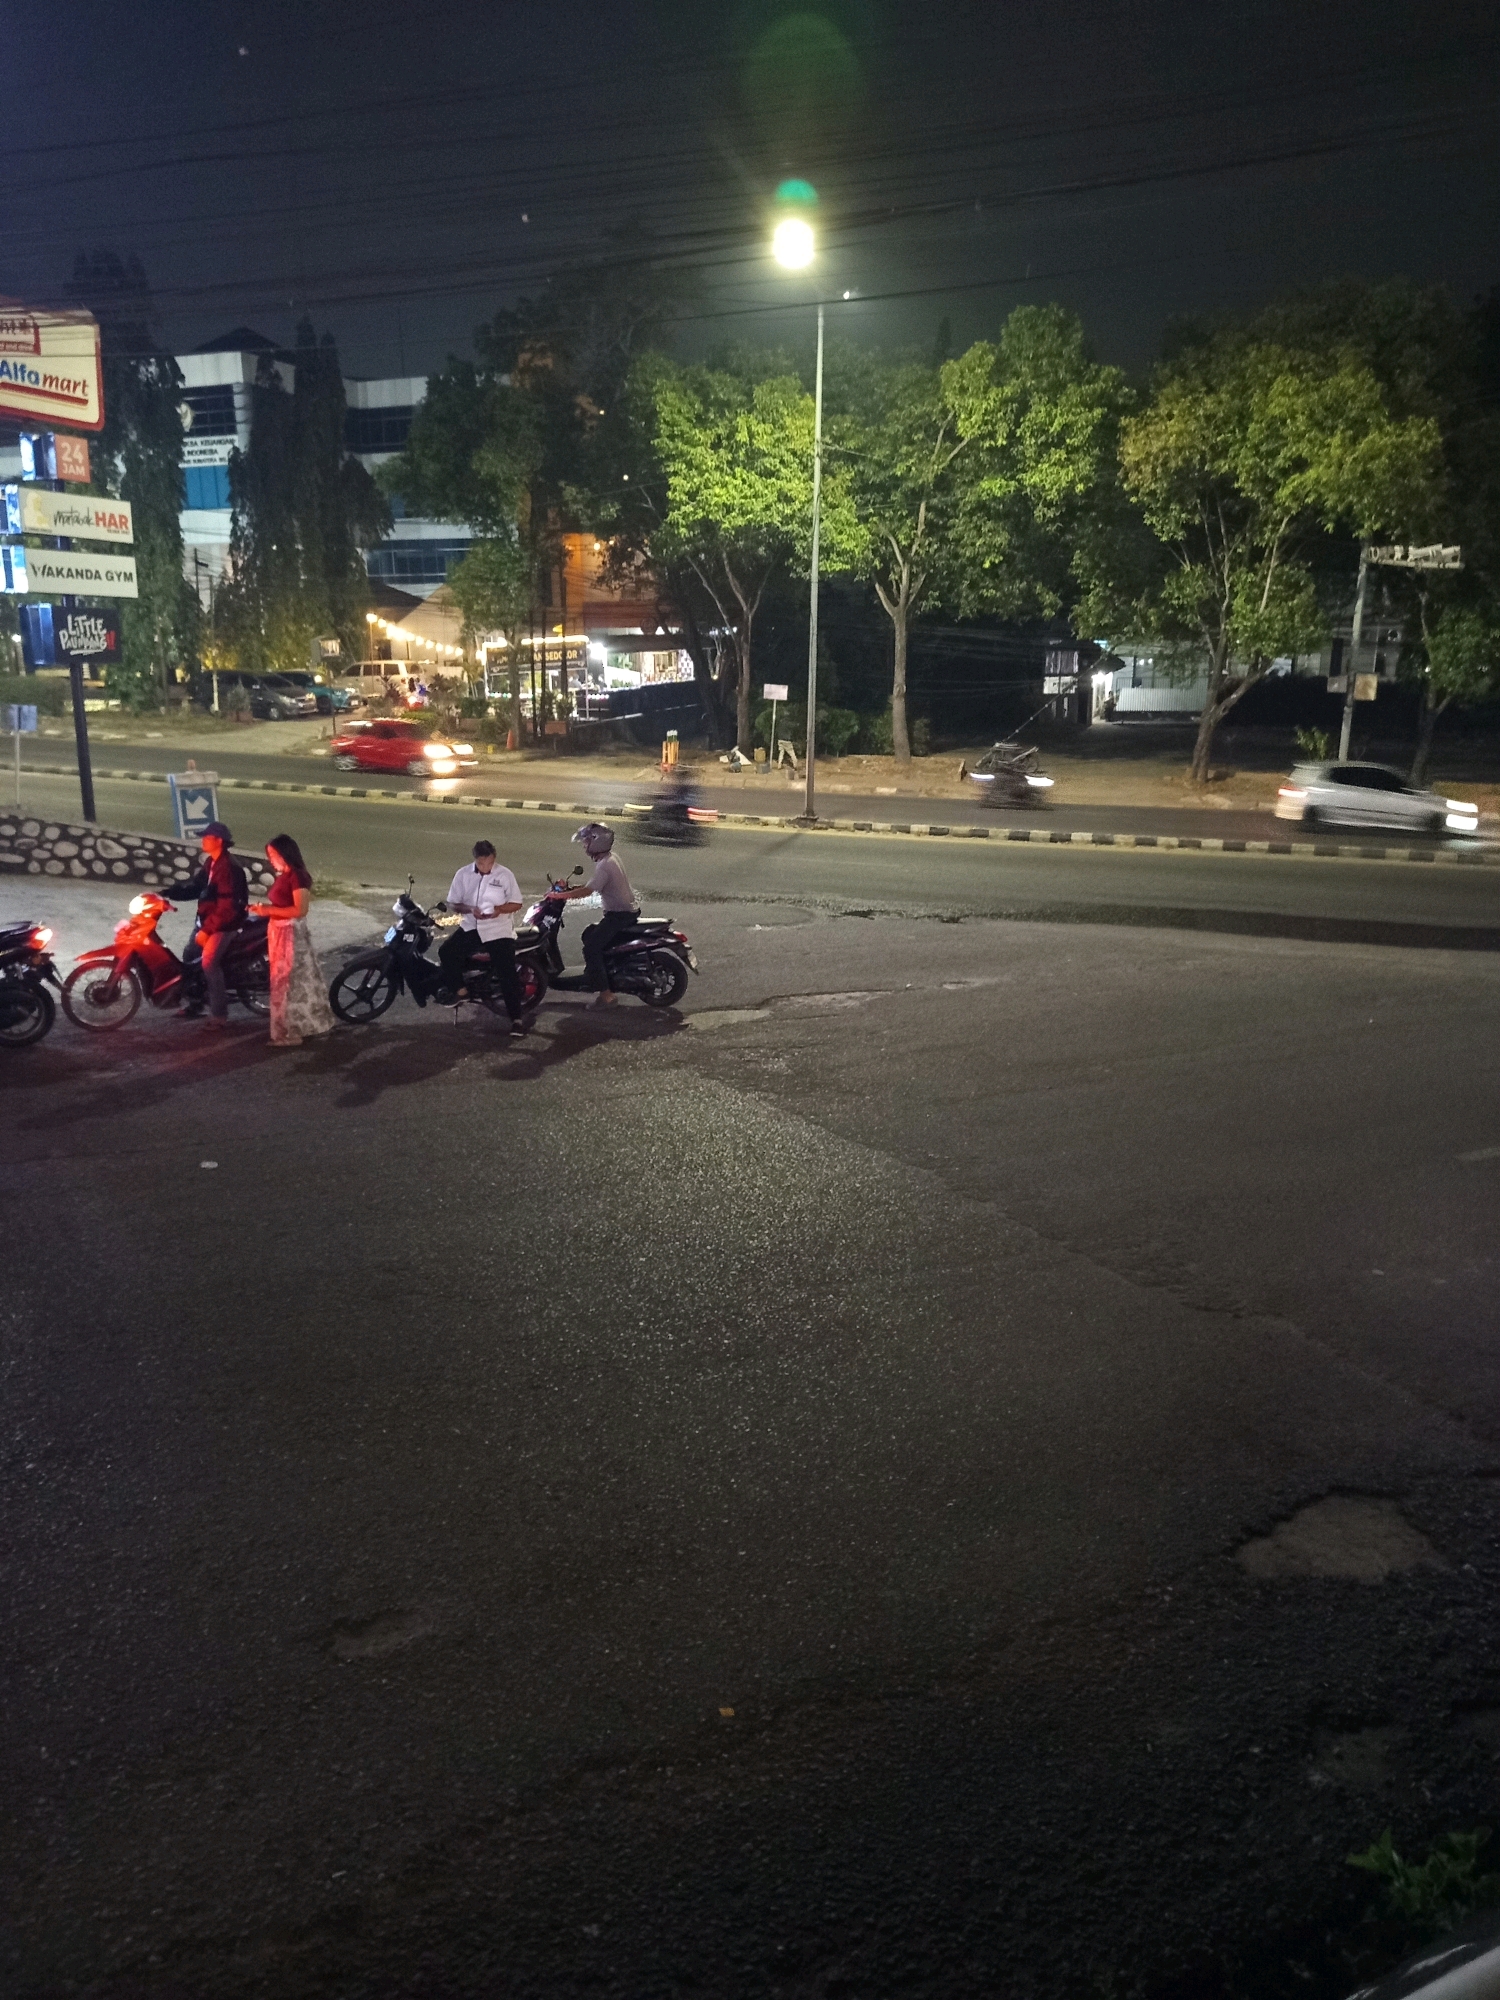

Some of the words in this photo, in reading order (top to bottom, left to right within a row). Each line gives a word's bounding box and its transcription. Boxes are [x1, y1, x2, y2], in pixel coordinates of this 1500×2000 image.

[0, 360, 89, 397] Alfamart
[61, 442, 84, 463] 24
[62, 462, 86, 476] JAM
[94, 510, 130, 531] HAR
[29, 562, 103, 581] WAKANDA
[105, 570, 134, 583] GYM
[545, 649, 578, 661] SEDOOR
